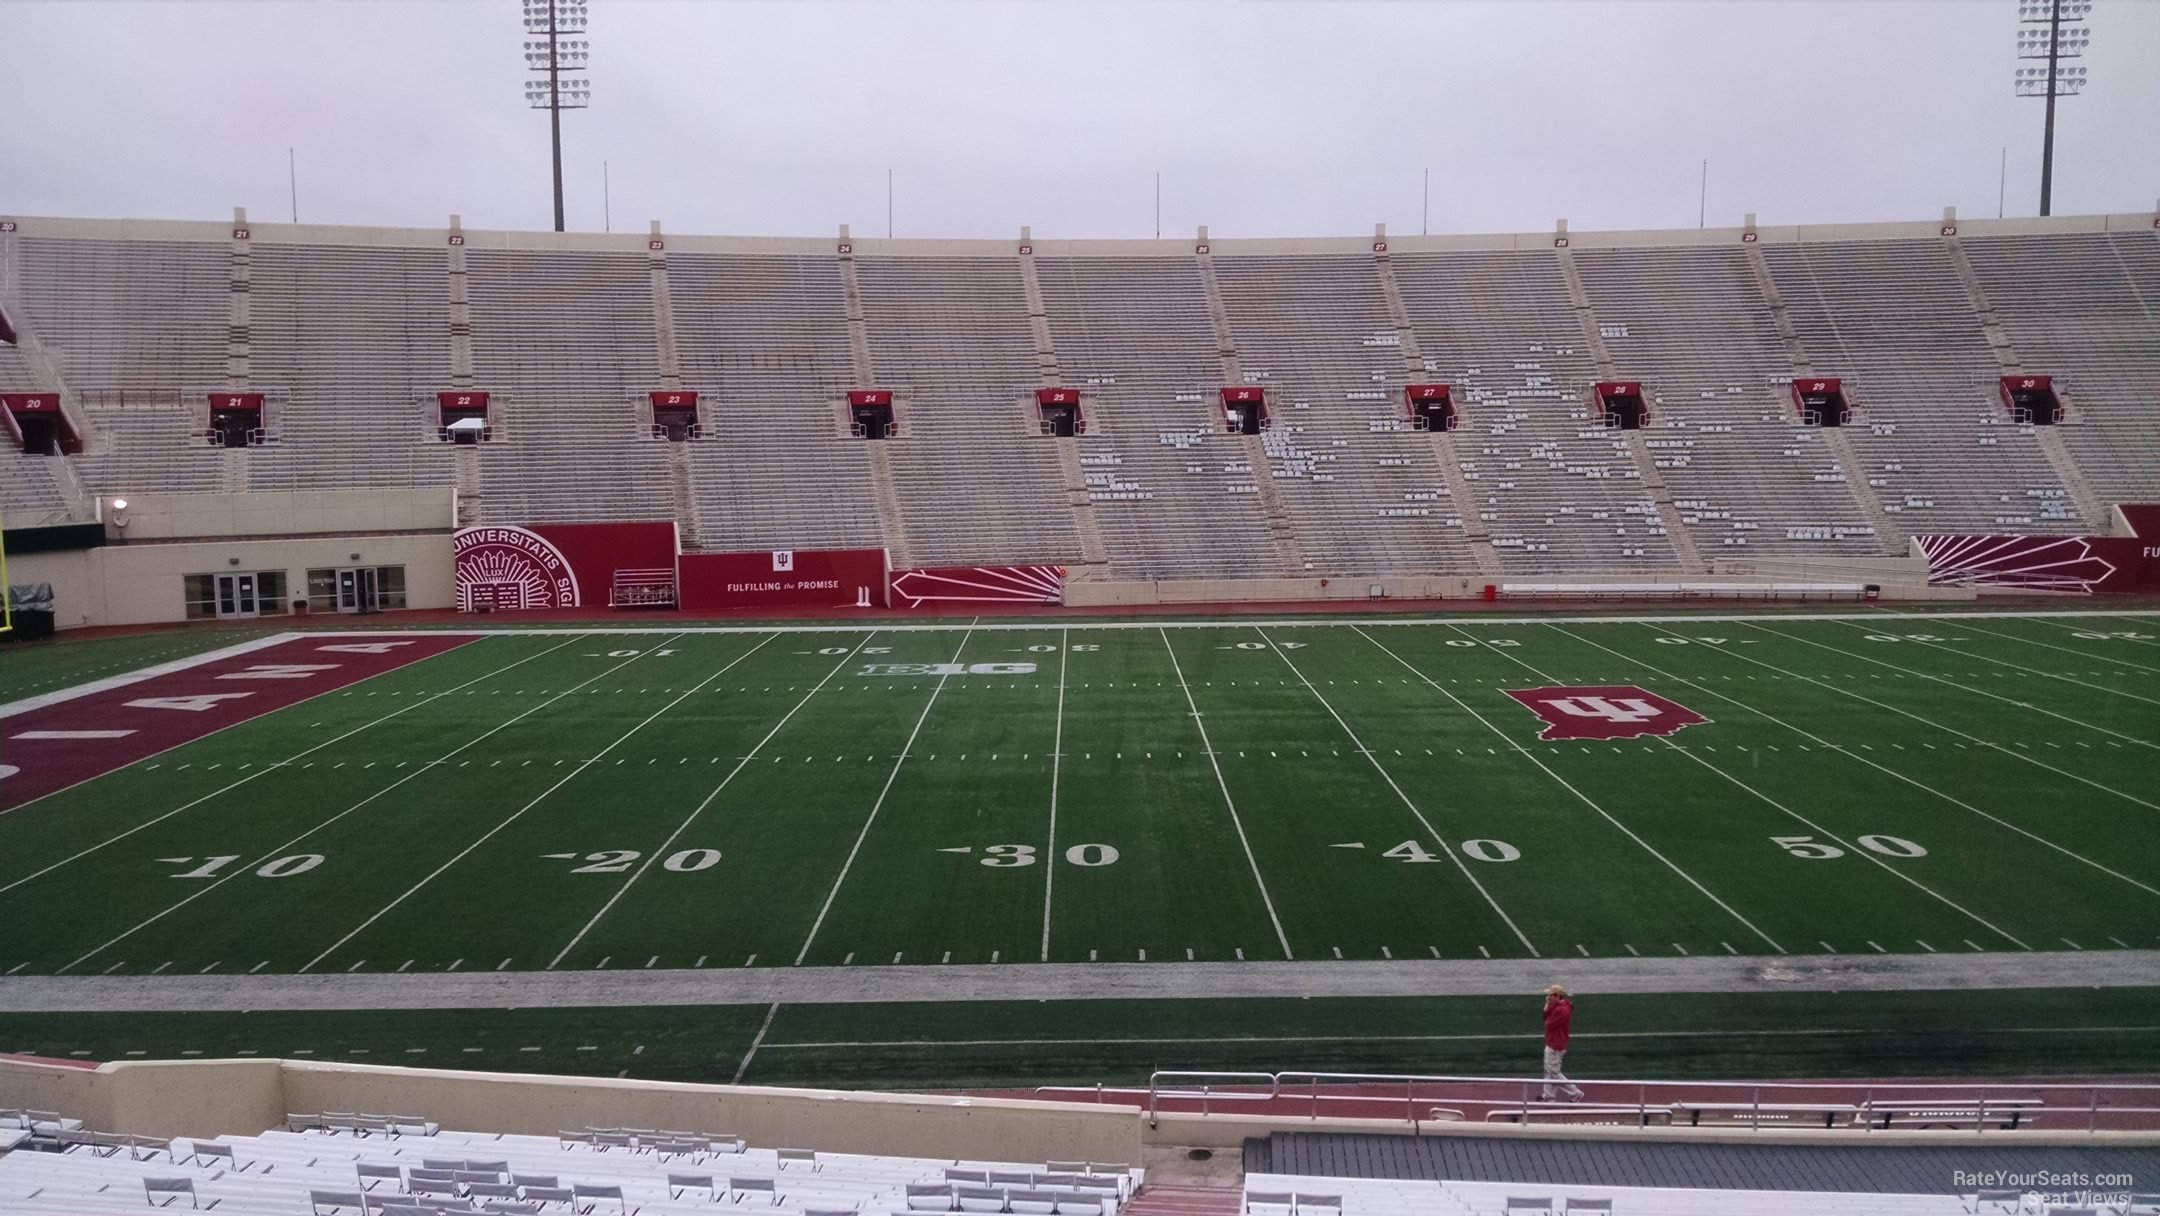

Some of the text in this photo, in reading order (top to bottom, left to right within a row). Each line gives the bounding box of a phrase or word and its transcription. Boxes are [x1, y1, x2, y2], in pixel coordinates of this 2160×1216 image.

[2, 223, 14, 231] 20
[451, 237, 462, 245] 22
[1745, 234, 1755, 242] 29
[1375, 243, 1385, 251] 27
[1813, 383, 1825, 391] 29
[2022, 380, 2035, 388] 30
[1424, 389, 1435, 397] 27
[1614, 386, 1626, 394] 28
[865, 395, 876, 403] 24
[1238, 391, 1249, 399] 26
[26, 399, 41, 408] 20
[229, 398, 242, 406] 21
[457, 396, 470, 405] 22
[668, 396, 680, 404] 23
[485, 569, 504, 577] LUX
[728, 582, 781, 592] FULFILLING
[798, 580, 839, 589] PROMISE
